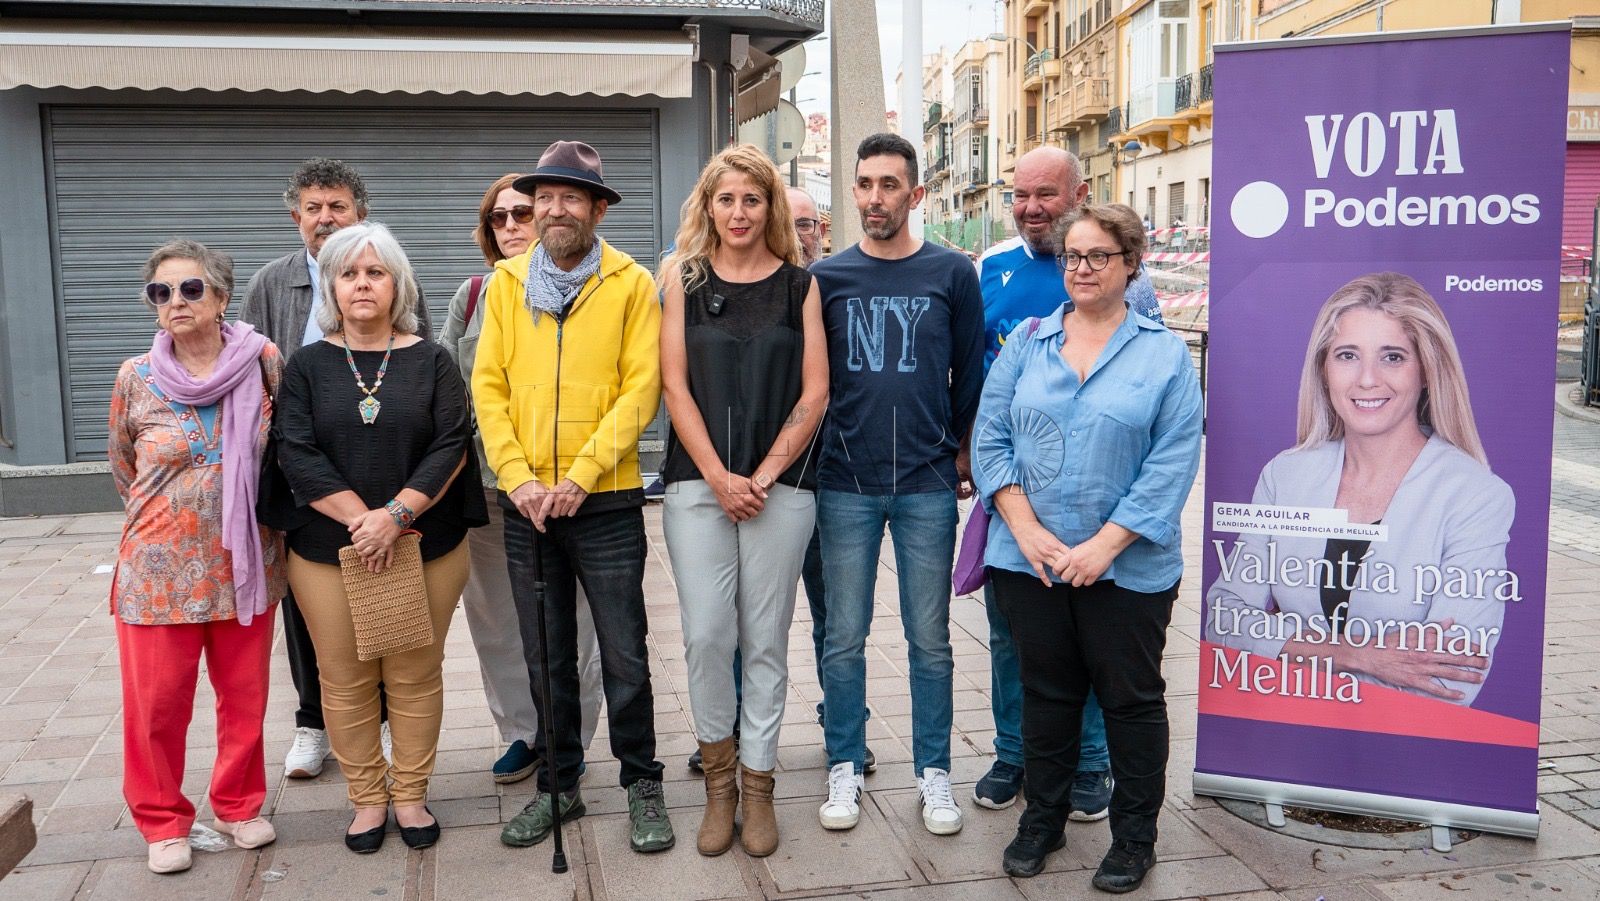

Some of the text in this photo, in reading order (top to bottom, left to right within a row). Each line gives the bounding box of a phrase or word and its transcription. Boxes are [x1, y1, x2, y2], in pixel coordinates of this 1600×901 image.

[1567, 110, 1600, 129] Chi
[1305, 109, 1464, 179] VOTA
[1304, 187, 1541, 228] Podemos
[1445, 275, 1543, 292] Podemos
[846, 296, 930, 373] NY
[1216, 520, 1259, 529] CANDIDATA
[1280, 524, 1331, 533] PRESIDENCIA
[1346, 528, 1380, 536] MELILLA
[1217, 507, 1310, 521] GEMA AGUILAR
[1212, 539, 1523, 604] Valentía para
[1211, 596, 1500, 658] transformar
[1209, 648, 1362, 703] Melilla
